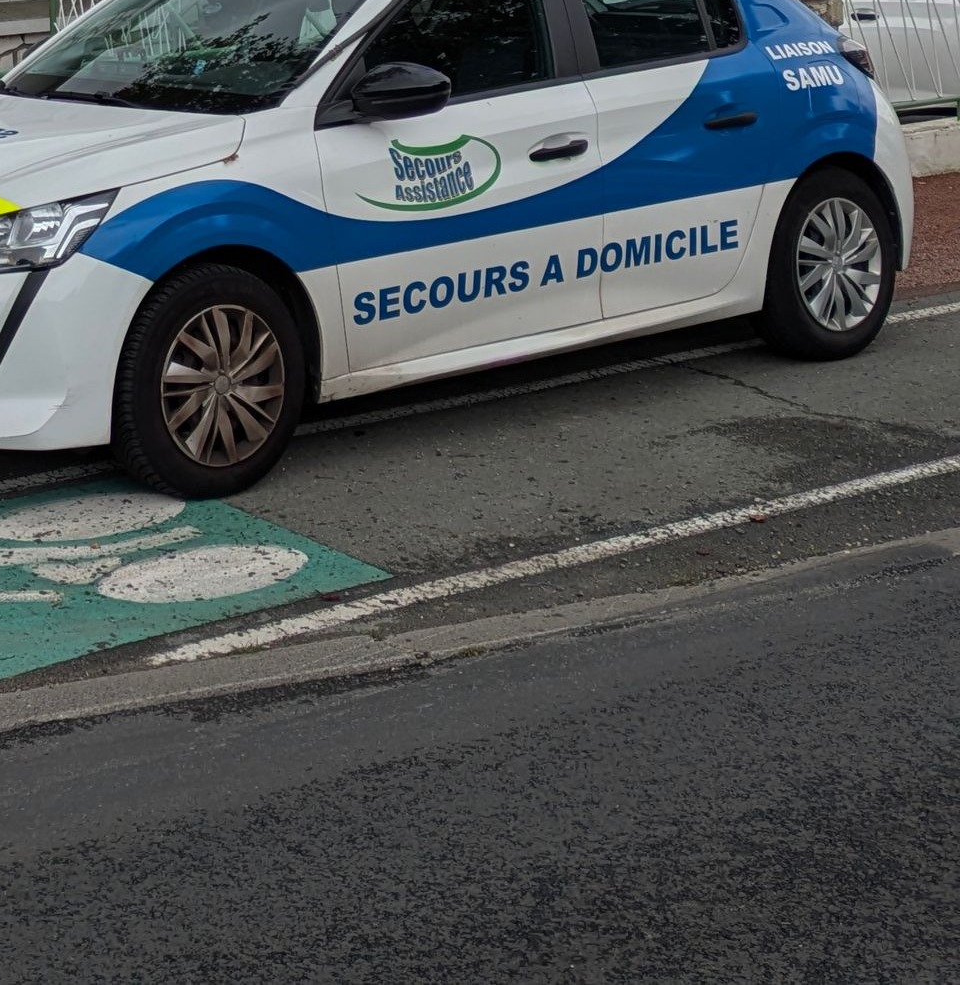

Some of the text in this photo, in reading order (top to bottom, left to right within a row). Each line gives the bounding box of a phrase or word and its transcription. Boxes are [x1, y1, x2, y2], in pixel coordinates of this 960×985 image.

[765, 41, 835, 60] LIAISON
[783, 66, 844, 91] SAMU
[388, 147, 463, 181] Secours
[395, 161, 474, 203] Assistance
[353, 219, 739, 326] SECOURS A DOMICILE
